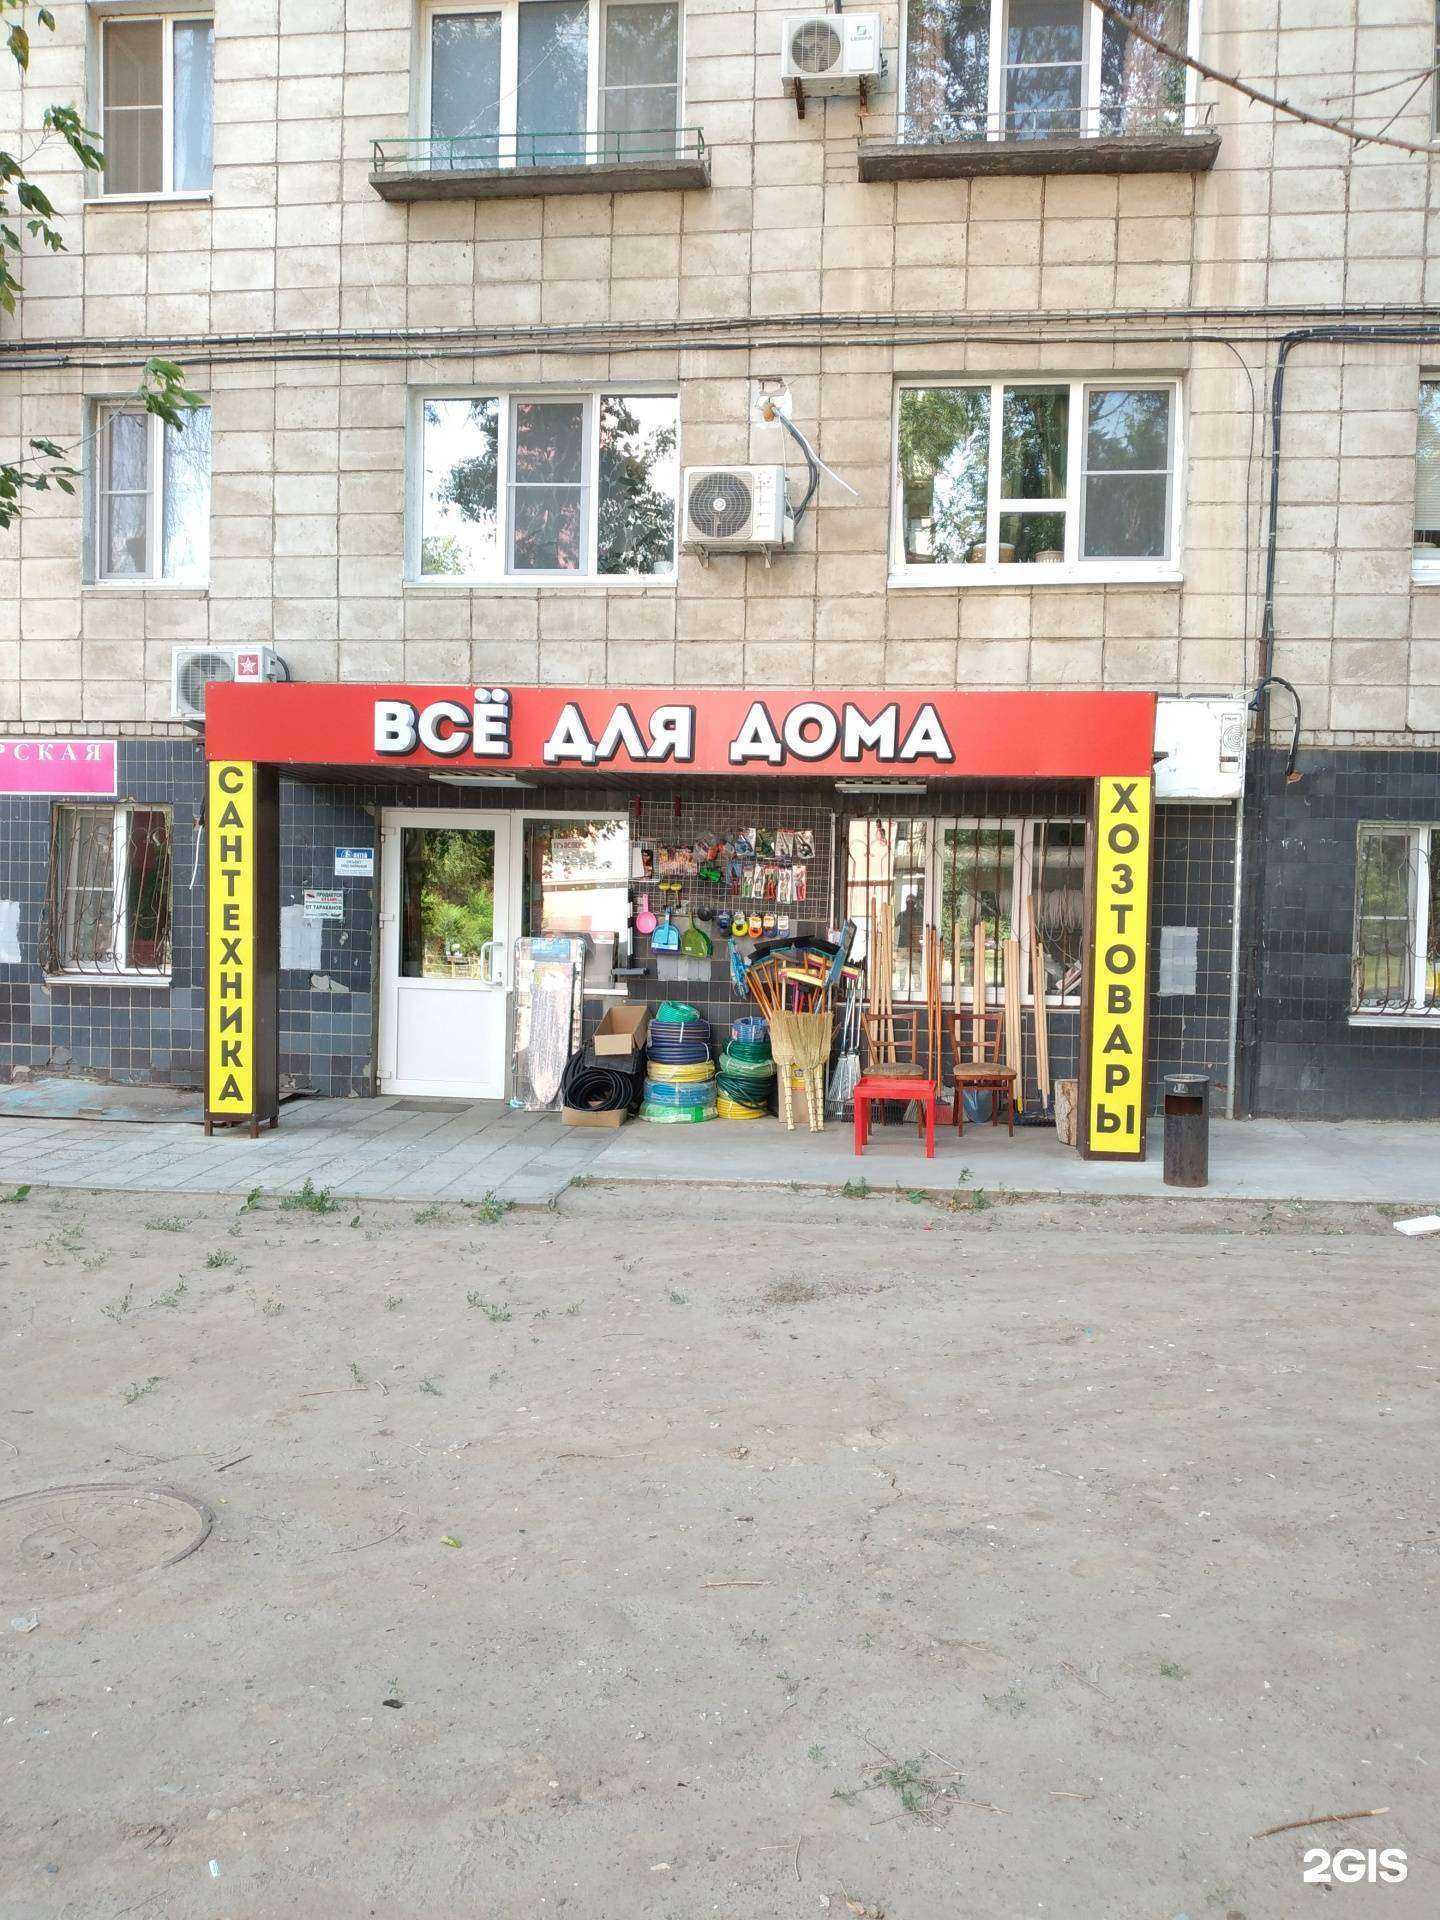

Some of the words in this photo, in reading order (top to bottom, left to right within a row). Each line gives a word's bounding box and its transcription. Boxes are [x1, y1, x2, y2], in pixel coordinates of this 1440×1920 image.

[374, 688, 512, 759] ВСЁ
[543, 702, 697, 766] ДЛЯ
[729, 701, 956, 766] ДОМА
[218, 766, 245, 1102] САНТЕХНИКА
[1096, 782, 1140, 1135] ХОЗТОВАРЫ
